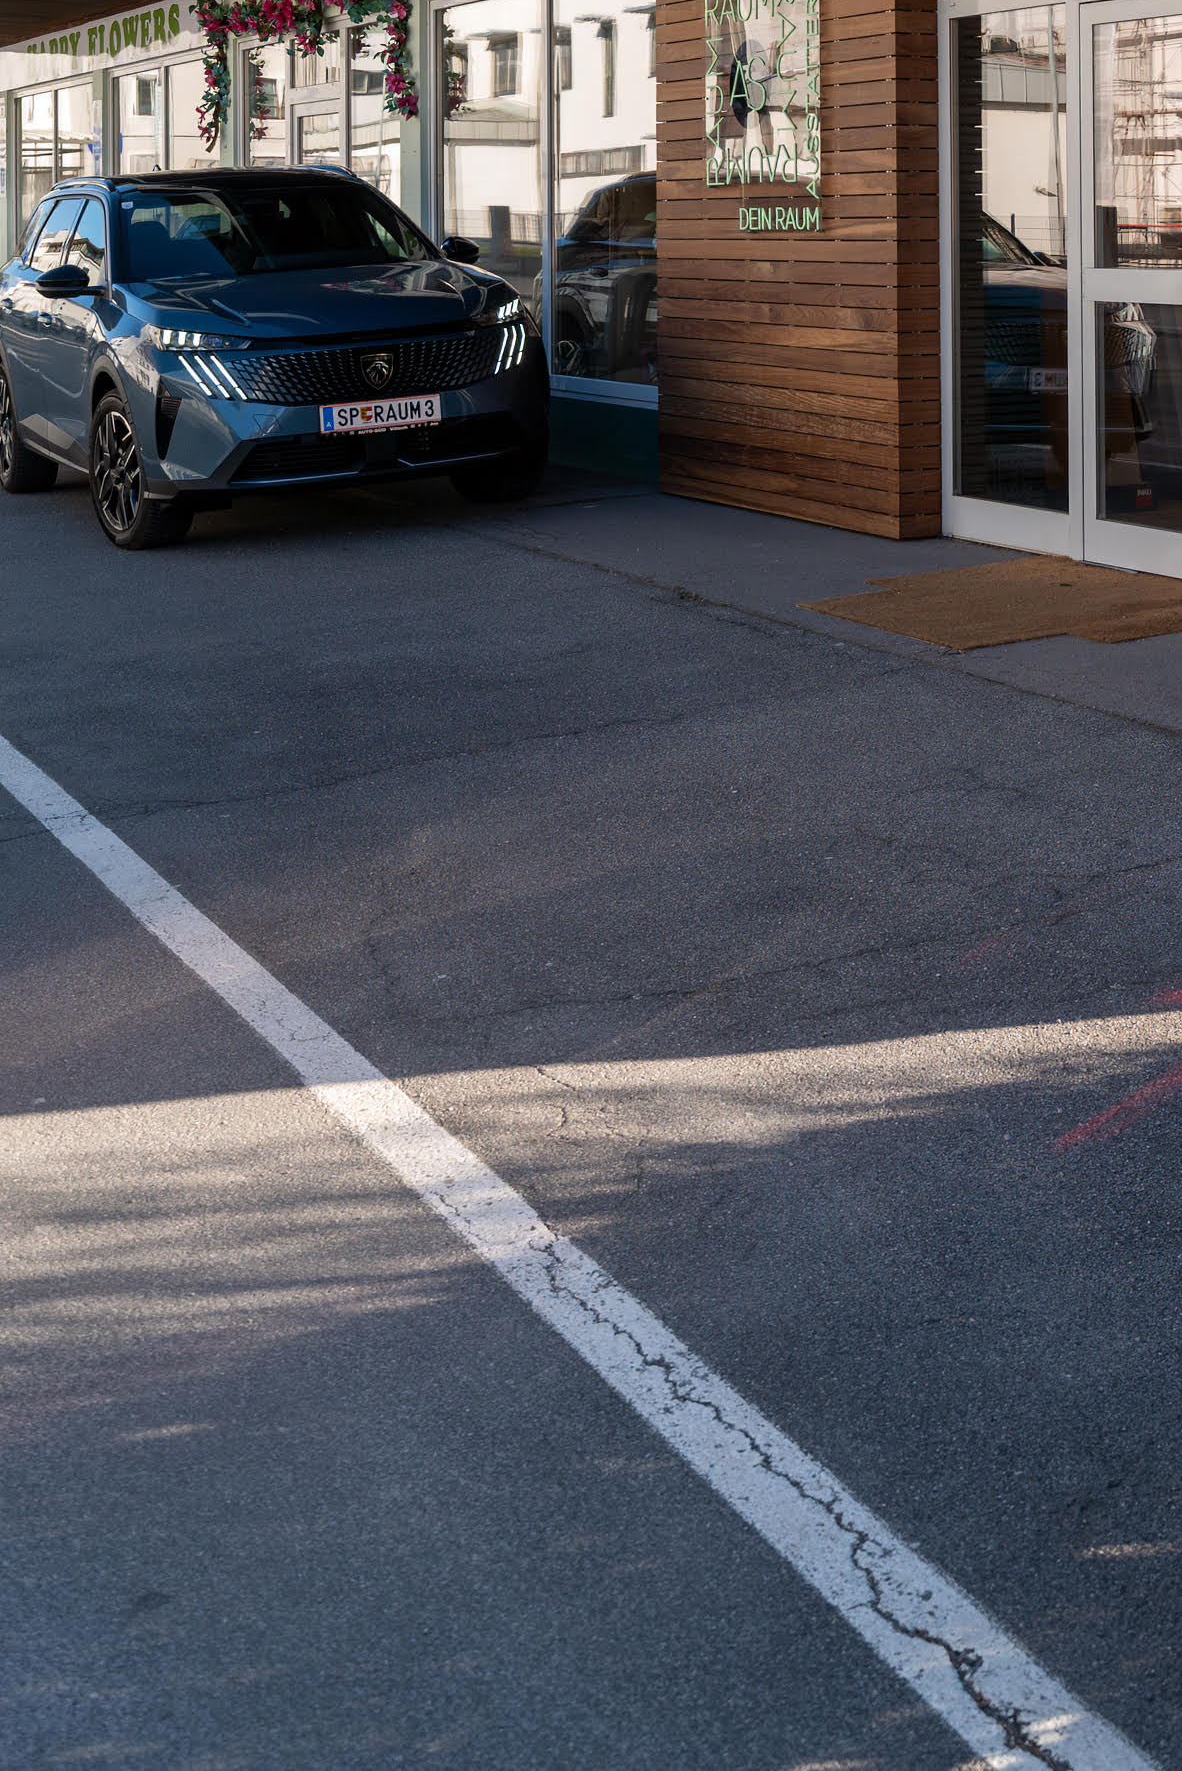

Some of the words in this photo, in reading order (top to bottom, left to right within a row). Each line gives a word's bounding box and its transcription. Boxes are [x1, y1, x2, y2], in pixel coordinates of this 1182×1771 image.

[87, 3, 181, 66] FLOWERS
[730, 56, 767, 112] AS
[705, 37, 725, 187] RAUM
[726, 143, 798, 185] RAUM
[738, 207, 772, 231] DEIN
[775, 206, 820, 231] RAUM
[337, 408, 359, 427] SP
[374, 401, 421, 423] RAUM
[425, 399, 435, 418] 3
